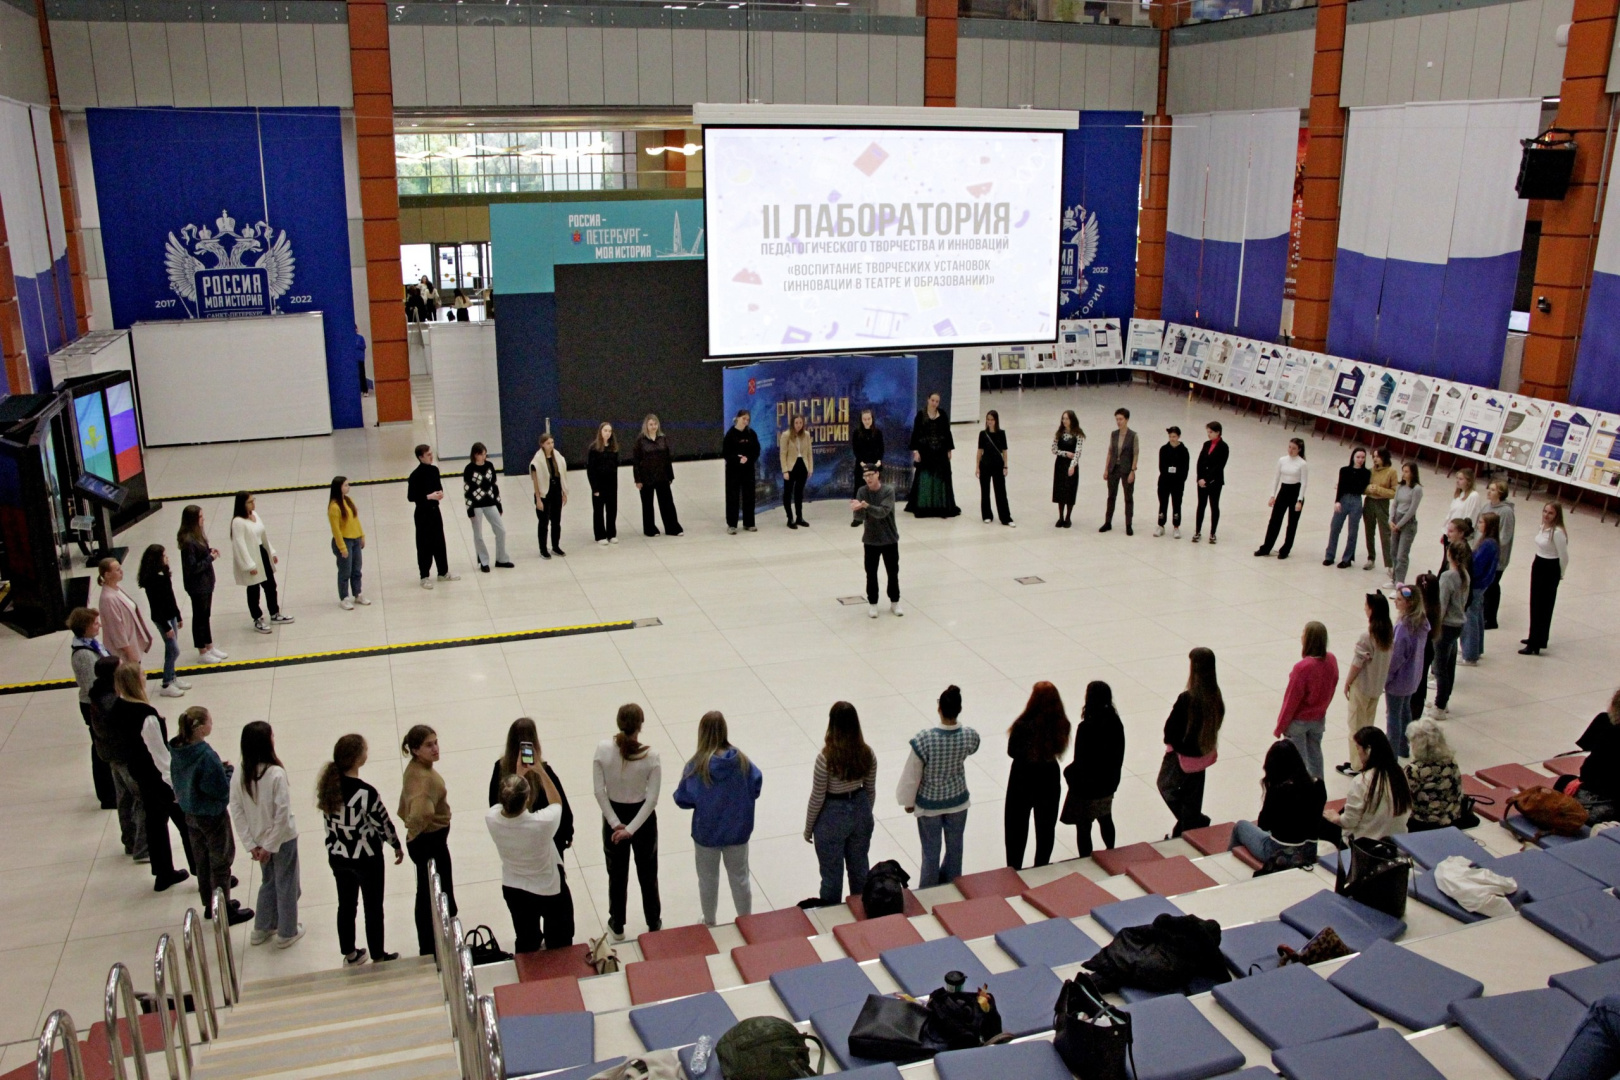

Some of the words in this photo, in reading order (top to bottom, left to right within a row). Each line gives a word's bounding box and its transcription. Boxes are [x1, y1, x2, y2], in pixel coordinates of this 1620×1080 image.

[790, 202, 1010, 238] ЛАБОРАТОРИЯ
[595, 246, 614, 259] МОЯ
[615, 245, 652, 259] ИСТОРИЯ
[761, 240, 867, 256] ПЕДАГОГИЧЕСКОГО
[870, 239, 935, 253] ТВОРЧЕСТВА
[938, 239, 945, 251] И
[948, 236, 1009, 251] ИННОВАЦИЙ
[787, 262, 863, 276] «ВОСПИТАНИЕ
[866, 261, 931, 274] ТВОРЧЕСКИХ
[934, 259, 991, 272] УСТАНОВОК
[202, 274, 262, 296] РОССИЯ
[855, 277, 862, 290] В
[865, 276, 902, 289] ТЕАТРЕ
[904, 276, 911, 288] И
[155, 299, 176, 308] 2017
[204, 295, 224, 309] МОЯ
[225, 294, 263, 308] ИСТОРИЯ
[290, 295, 312, 304] 2022
